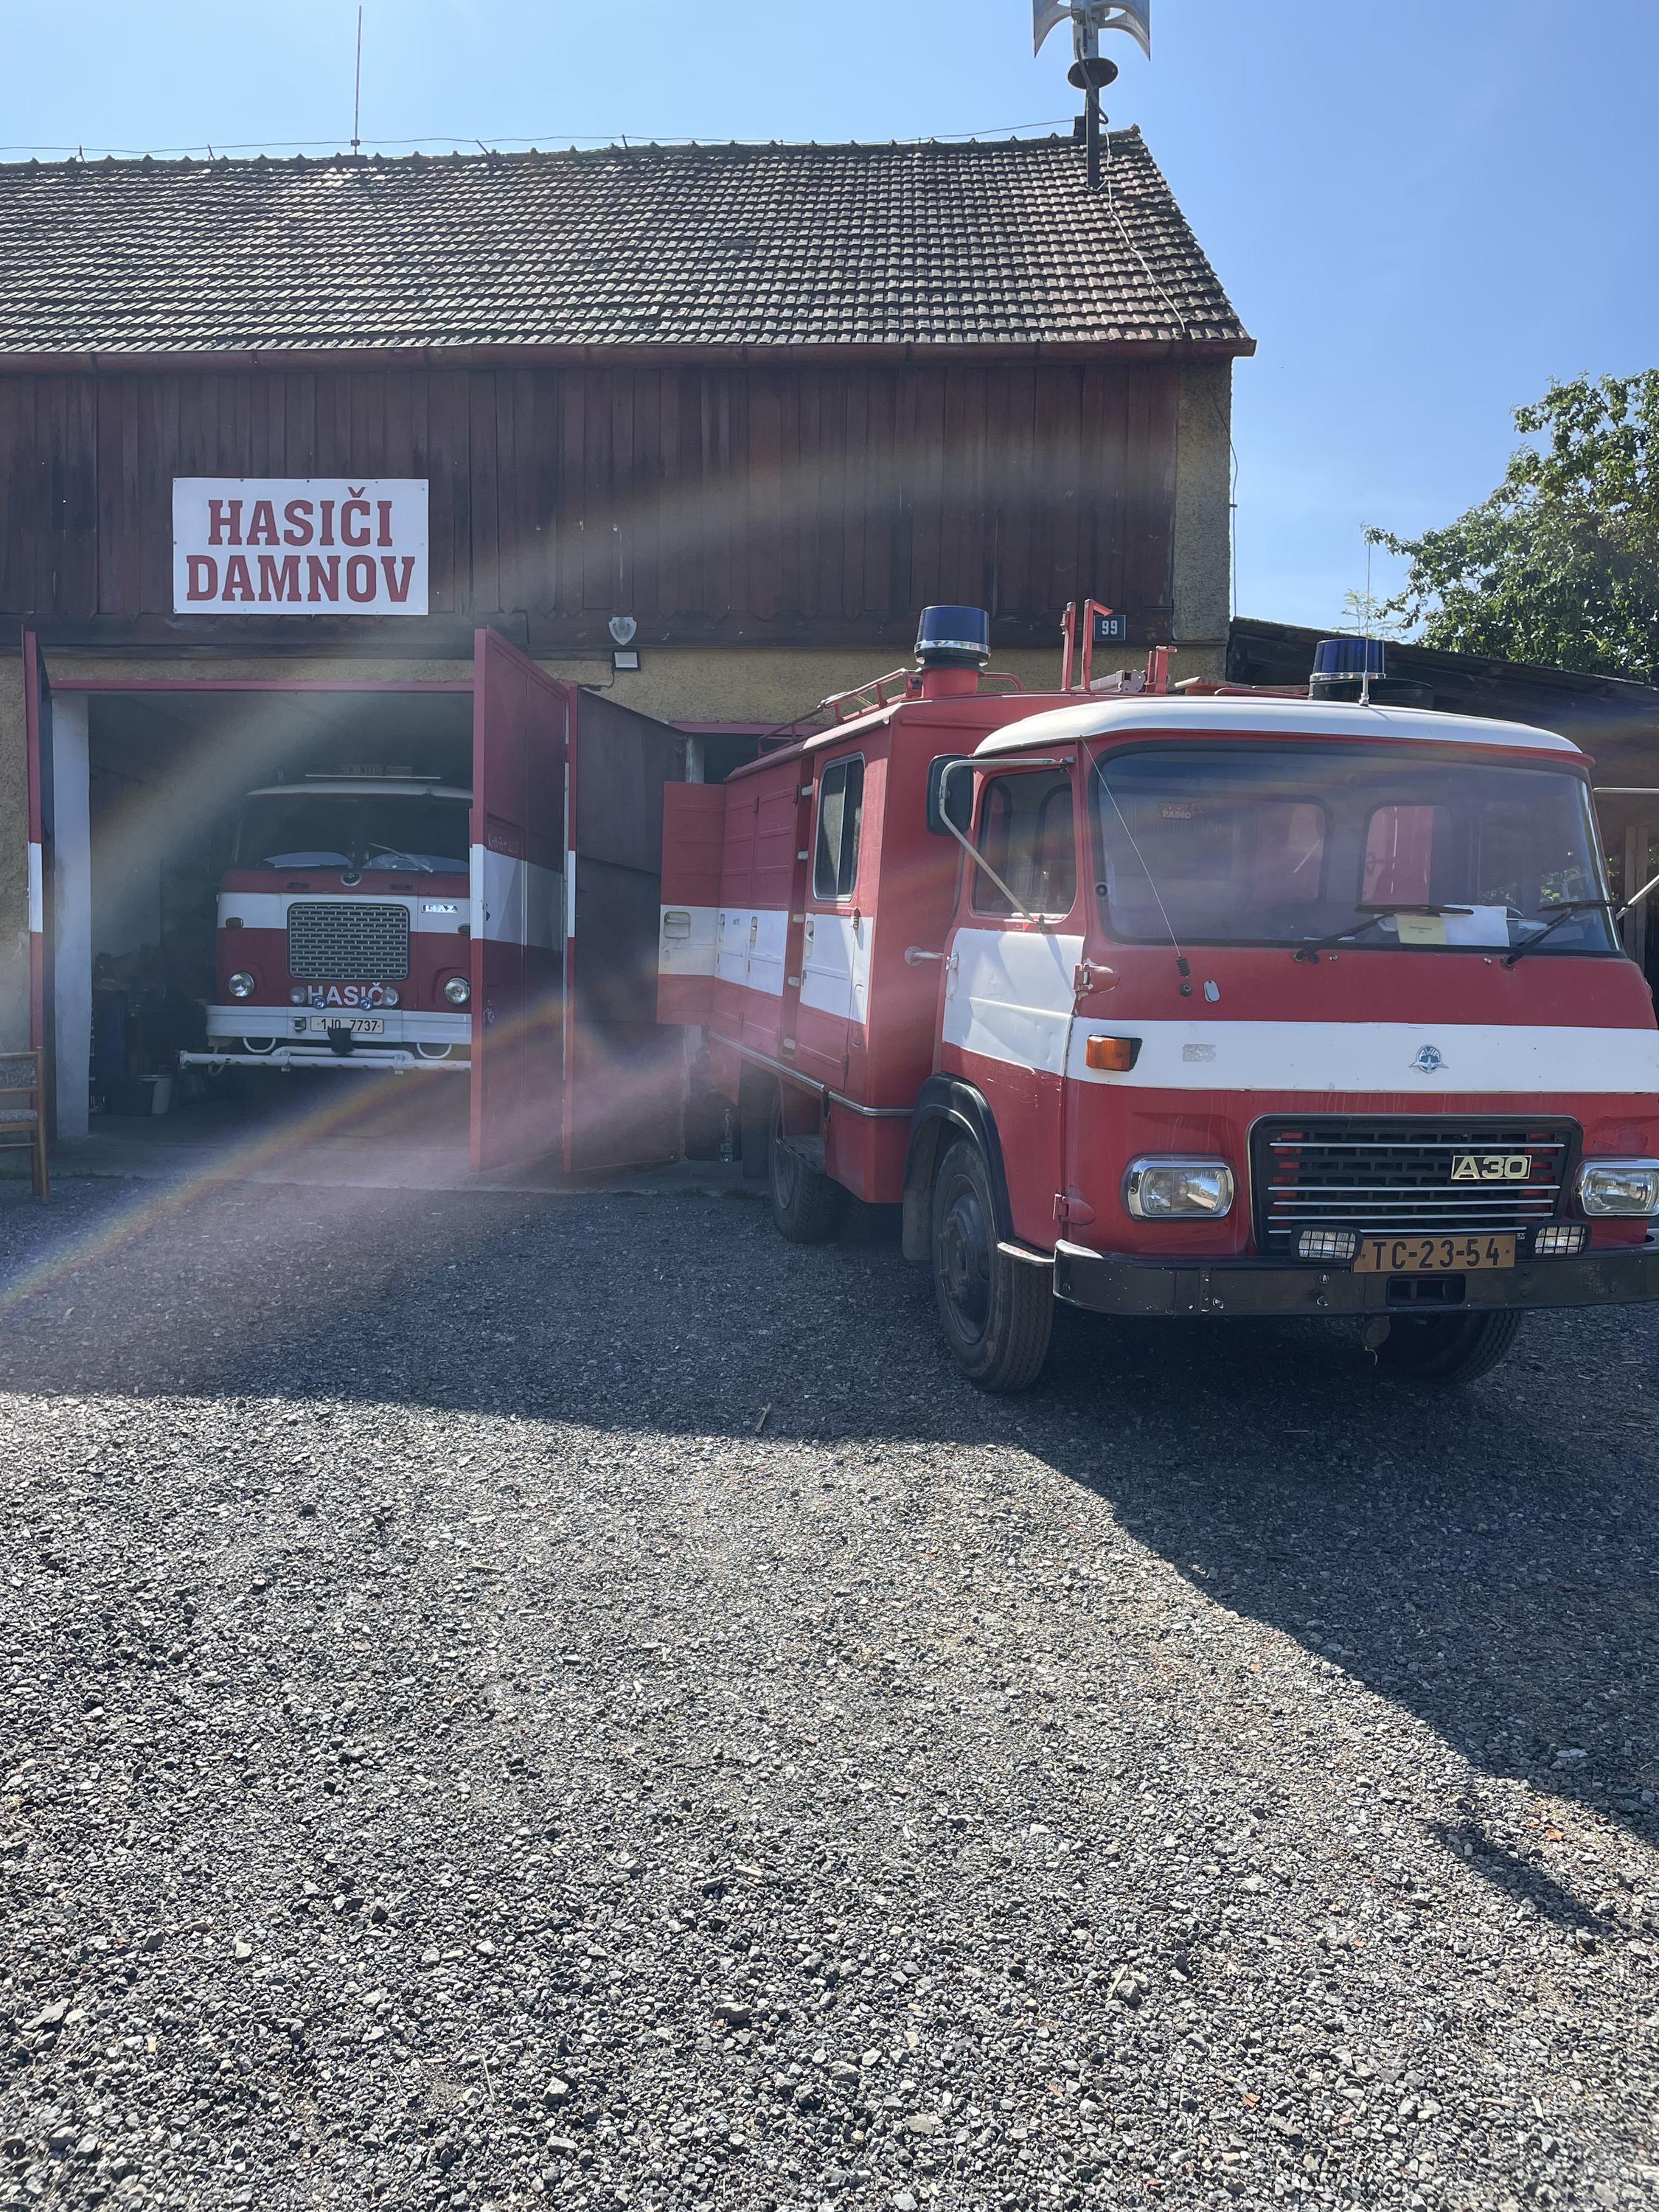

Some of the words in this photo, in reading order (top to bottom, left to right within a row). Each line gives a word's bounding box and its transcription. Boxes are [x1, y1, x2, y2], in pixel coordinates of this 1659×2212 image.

[208, 487, 393, 547] HASIČI
[186, 554, 415, 602] DAMNOV
[1102, 620, 1118, 635] 99
[1162, 810, 1192, 819] RADIO
[307, 982, 392, 1006] HASIČ
[349, 1020, 378, 1032] 7737
[1453, 1156, 1528, 1178] A30
[1372, 1239, 1500, 1270] TC-23-54
